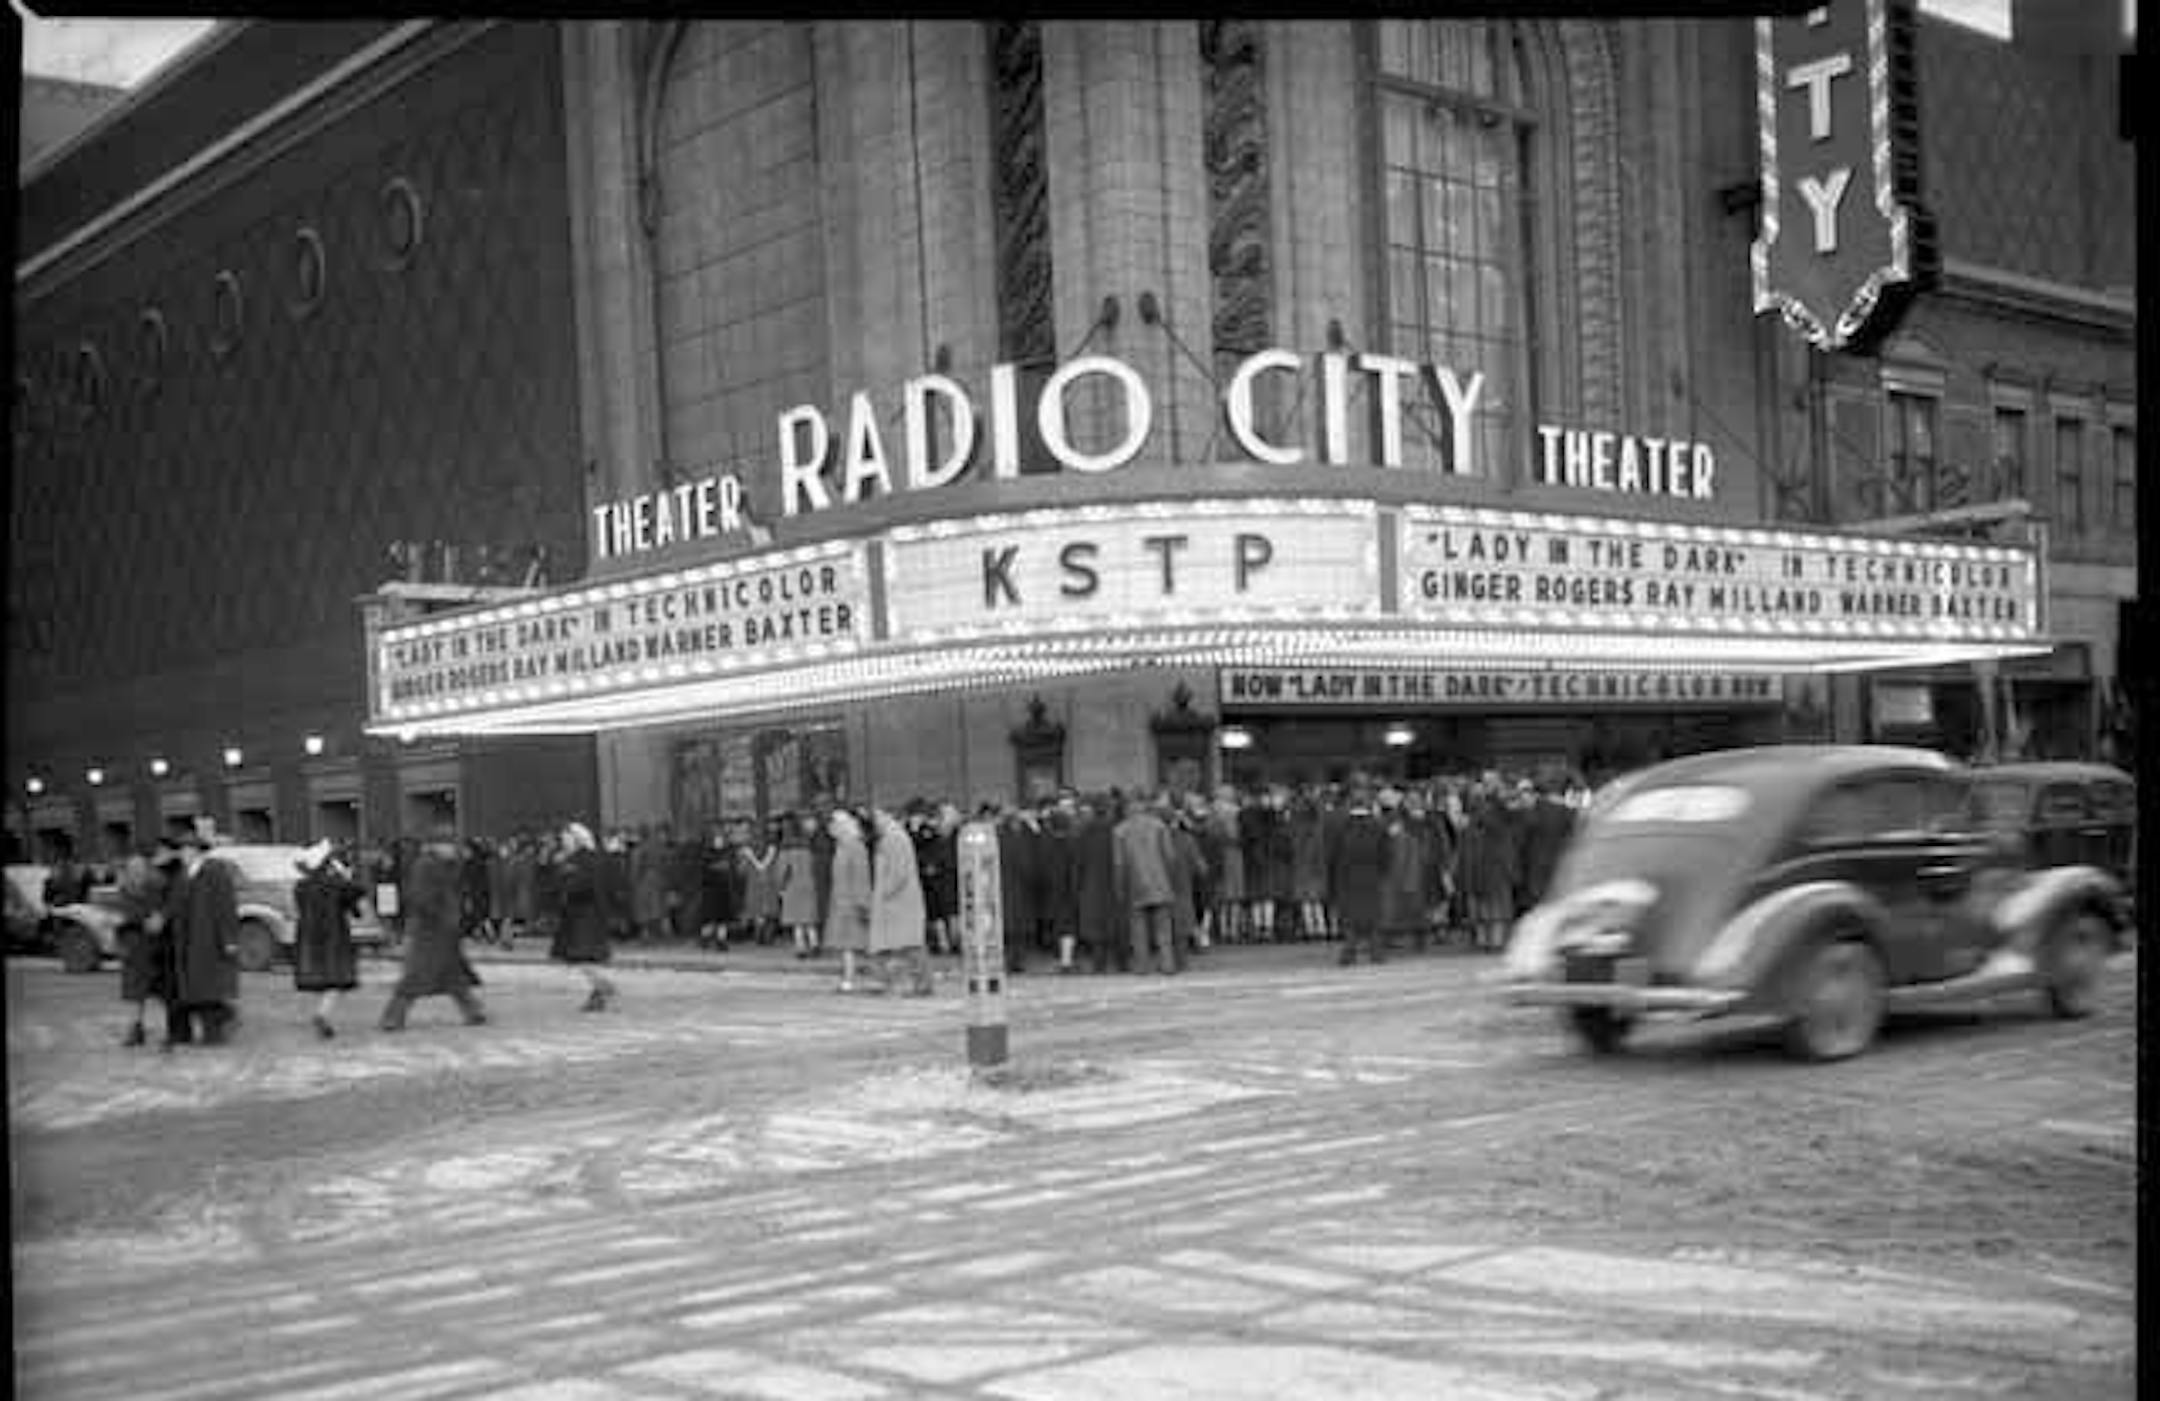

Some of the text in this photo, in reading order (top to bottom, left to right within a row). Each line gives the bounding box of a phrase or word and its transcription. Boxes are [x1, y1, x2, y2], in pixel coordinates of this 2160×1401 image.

[1786, 8, 1851, 252] TY
[779, 349, 1484, 516] RADIO CITY
[1538, 425, 1713, 499] THEATER
[594, 475, 741, 558] THEATER
[1422, 571, 2015, 619] GINGER ROGERS RAY MILLAND WARNER BAXTER
[1550, 539, 1568, 563] IN
[1588, 540, 1642, 568] THE
[1782, 554, 1802, 578] IN
[1827, 556, 2009, 588] TECHNICOLOR
[477, 626, 507, 652] THE
[594, 609, 610, 632] IN
[629, 566, 834, 626] TECHNICOLOR
[513, 656, 548, 680] RAY
[556, 638, 640, 672] MILLAND
[645, 622, 732, 660] WARNER
[746, 603, 851, 646] BAXTER
[1233, 675, 1282, 697] NOW
[1363, 675, 1380, 697] IN
[1388, 675, 1434, 697] THE
